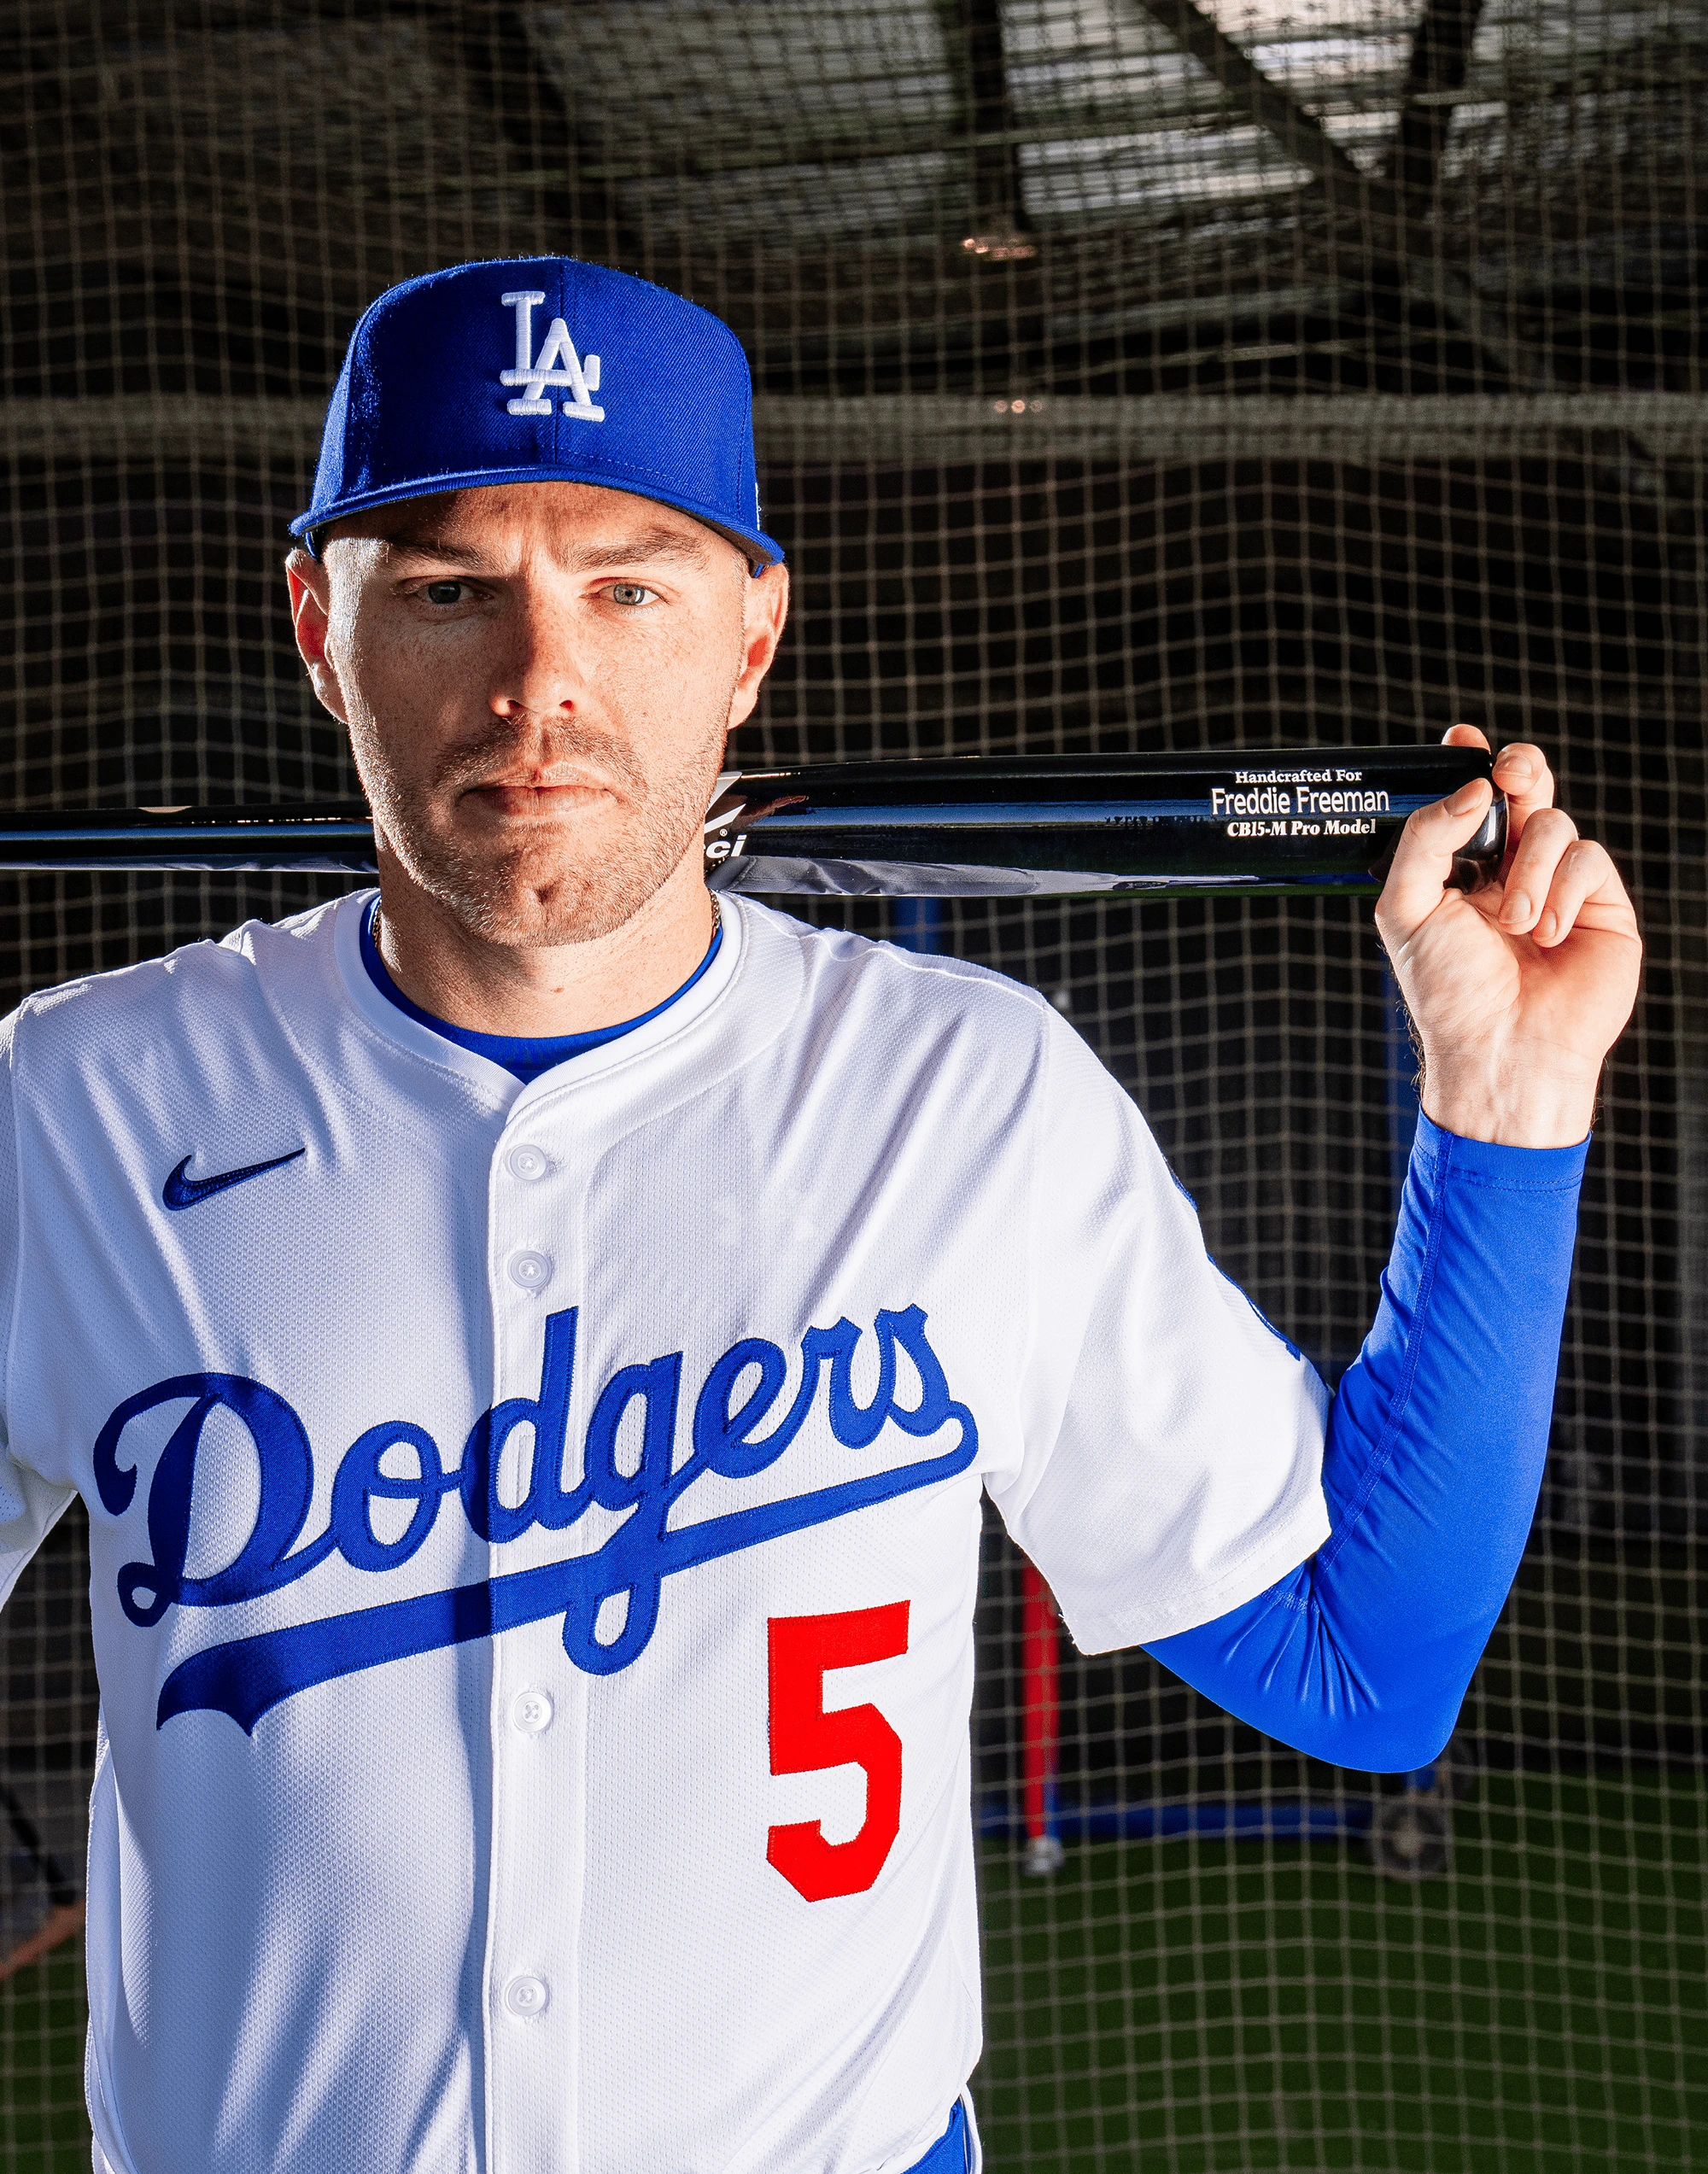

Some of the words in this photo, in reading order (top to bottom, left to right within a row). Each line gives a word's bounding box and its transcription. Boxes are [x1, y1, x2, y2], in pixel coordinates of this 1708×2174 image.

[500, 291, 605, 422] LA
[1236, 769, 1332, 784] Handcrafted
[1336, 769, 1362, 782] For
[1211, 786, 1290, 815] Freddie
[1296, 786, 1390, 814] Freeman
[1227, 821, 1288, 837] CB15-M
[1290, 821, 1320, 836] Pro
[1323, 819, 1377, 836] Model
[704, 834, 747, 859] ci
[93, 1303, 979, 1675] Dodgers
[767, 1600, 910, 1902] 5
